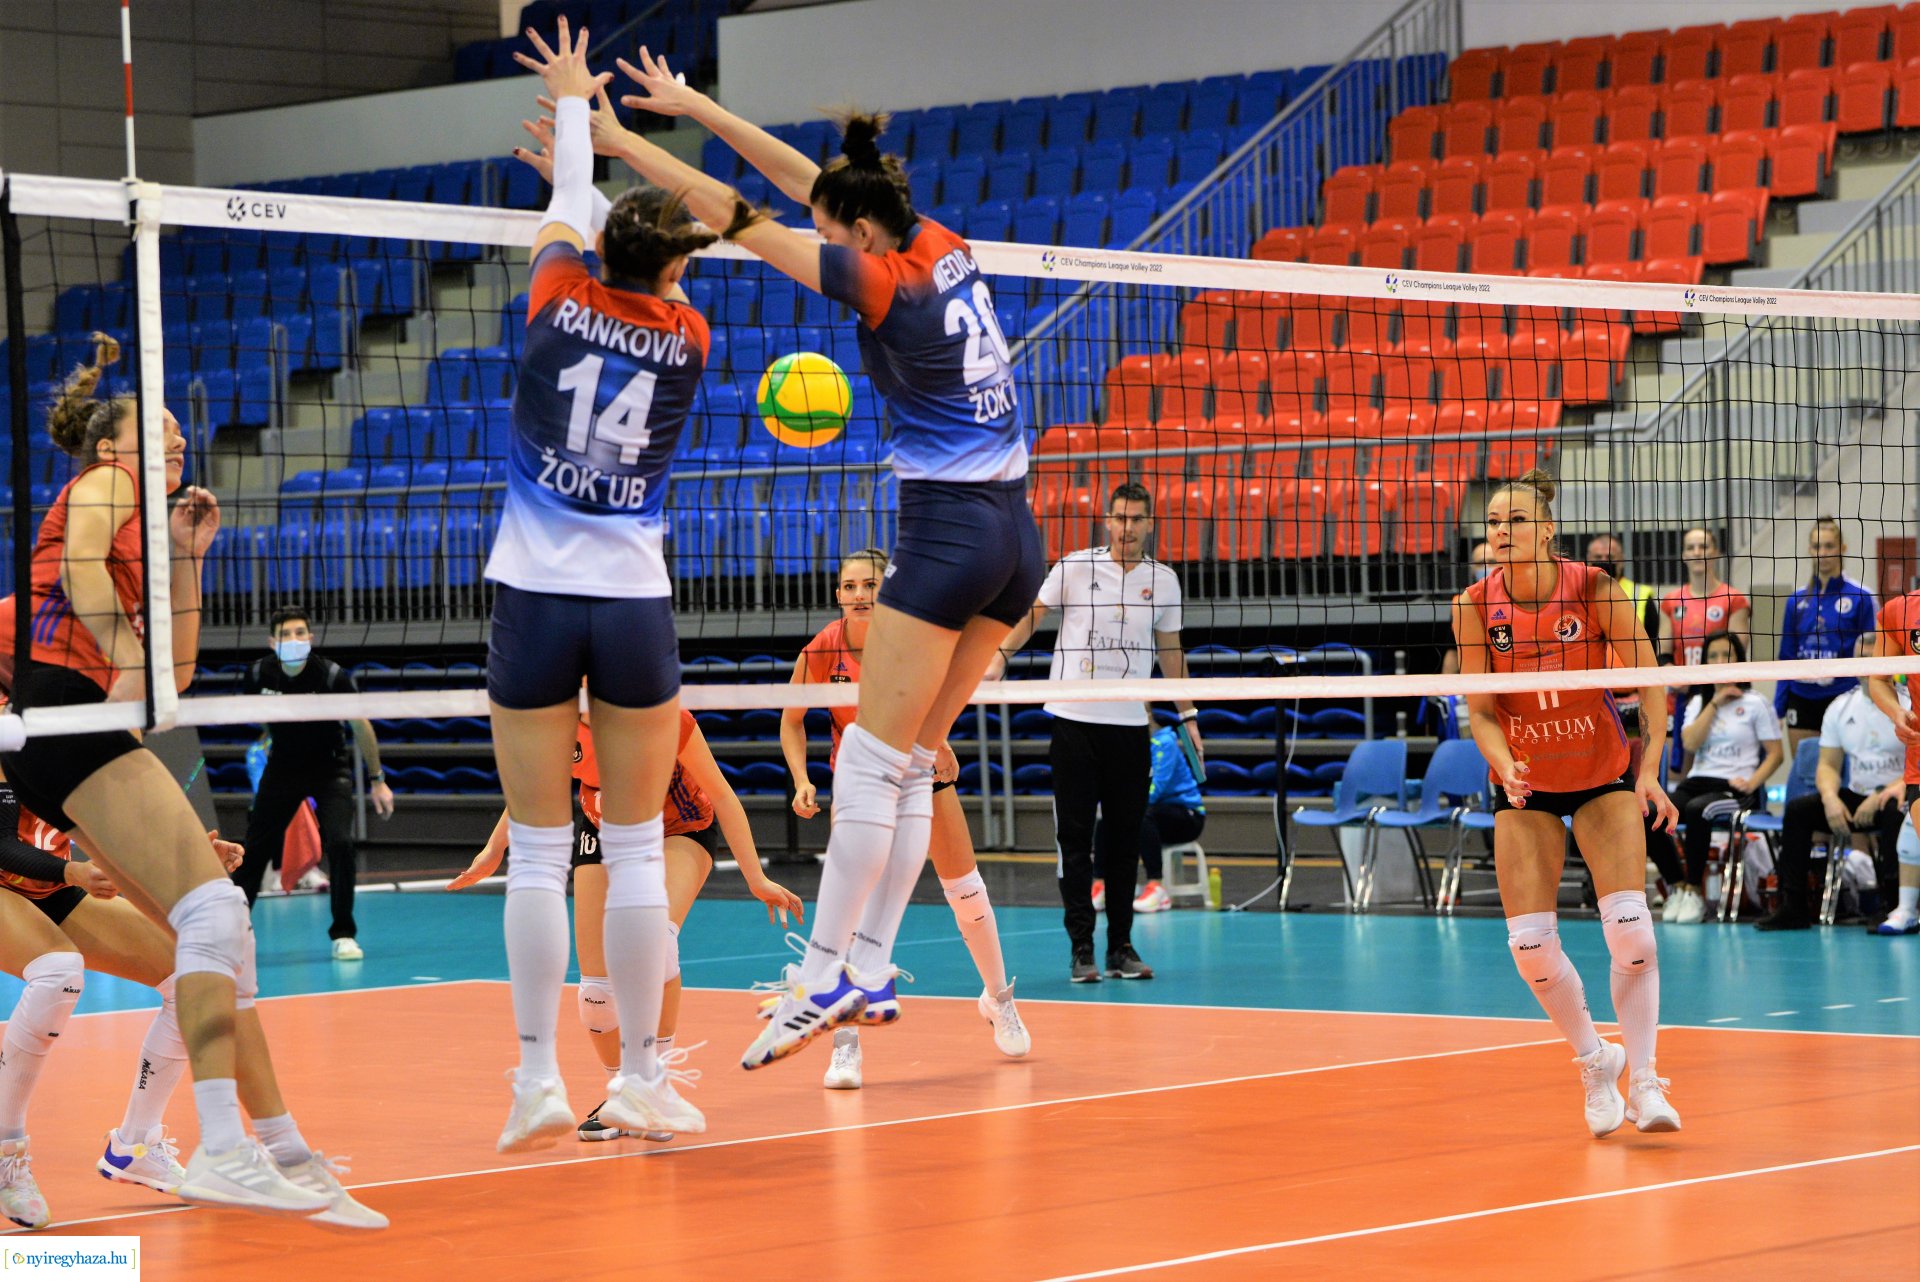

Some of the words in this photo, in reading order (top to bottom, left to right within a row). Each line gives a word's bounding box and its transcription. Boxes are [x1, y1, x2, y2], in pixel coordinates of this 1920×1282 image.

[251, 203, 286, 218] CEV
[1060, 257, 1073, 266] CEV
[1075, 258, 1107, 270] Champions
[1108, 261, 1130, 271] League
[1131, 262, 1148, 273] Volley
[1149, 263, 1163, 272] 2022
[1402, 280, 1413, 288] CEV
[1413, 280, 1442, 290] Champions
[1443, 282, 1462, 292] League
[1462, 283, 1478, 293] Volley
[1478, 284, 1491, 292] 2022
[1699, 294, 1708, 302] CEV
[1709, 295, 1735, 304] Champions
[1735, 296, 1752, 304] League
[1752, 296, 1766, 305] Volley
[1766, 297, 1777, 305] 2022
[557, 353, 652, 465] 14
[537, 446, 602, 502] ŽOK
[607, 474, 647, 510] UB
[1509, 714, 1596, 739] FATUM
